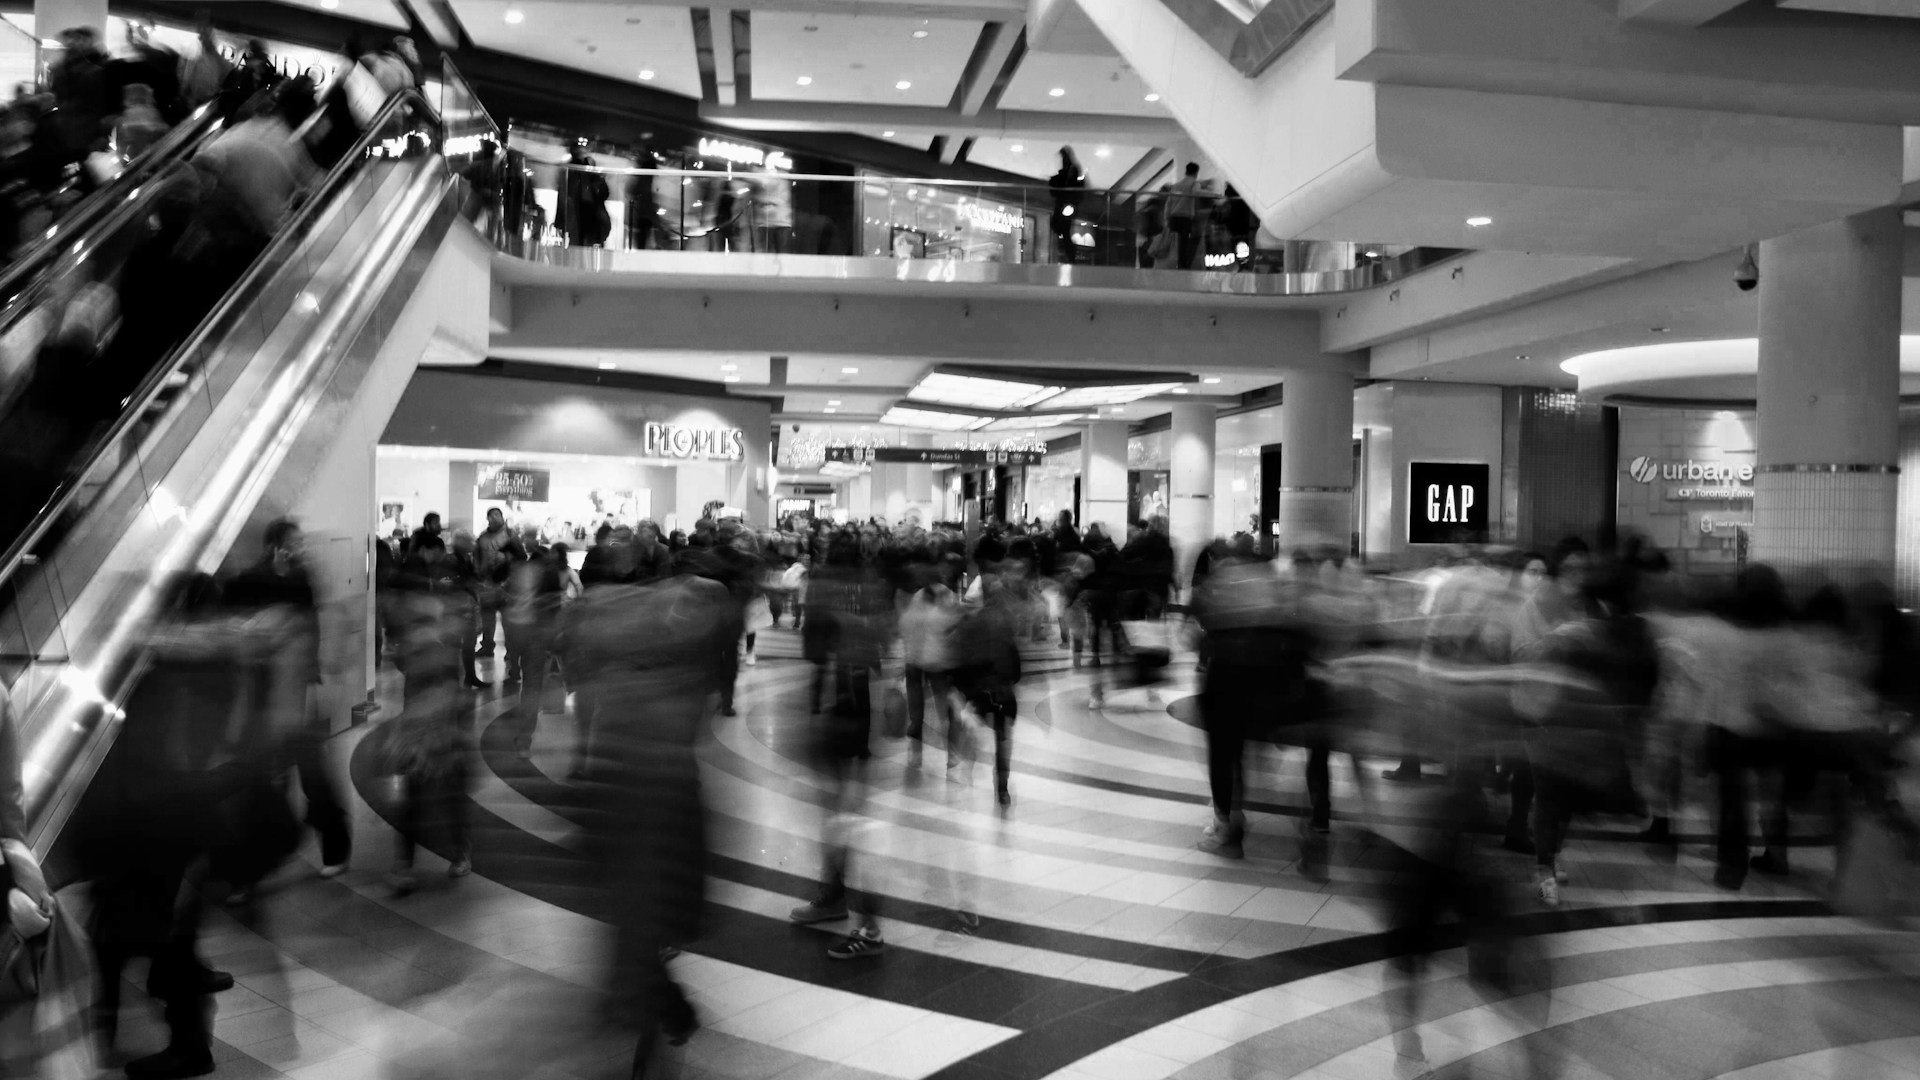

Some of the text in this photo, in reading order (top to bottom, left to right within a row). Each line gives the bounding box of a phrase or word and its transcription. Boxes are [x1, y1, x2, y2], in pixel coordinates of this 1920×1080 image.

[645, 422, 743, 460] PEOPLES
[930, 452, 953, 461] Dundas
[1662, 459, 1733, 480] urban
[1427, 484, 1474, 523] GAP
[1695, 488, 1730, 498] Toronto
